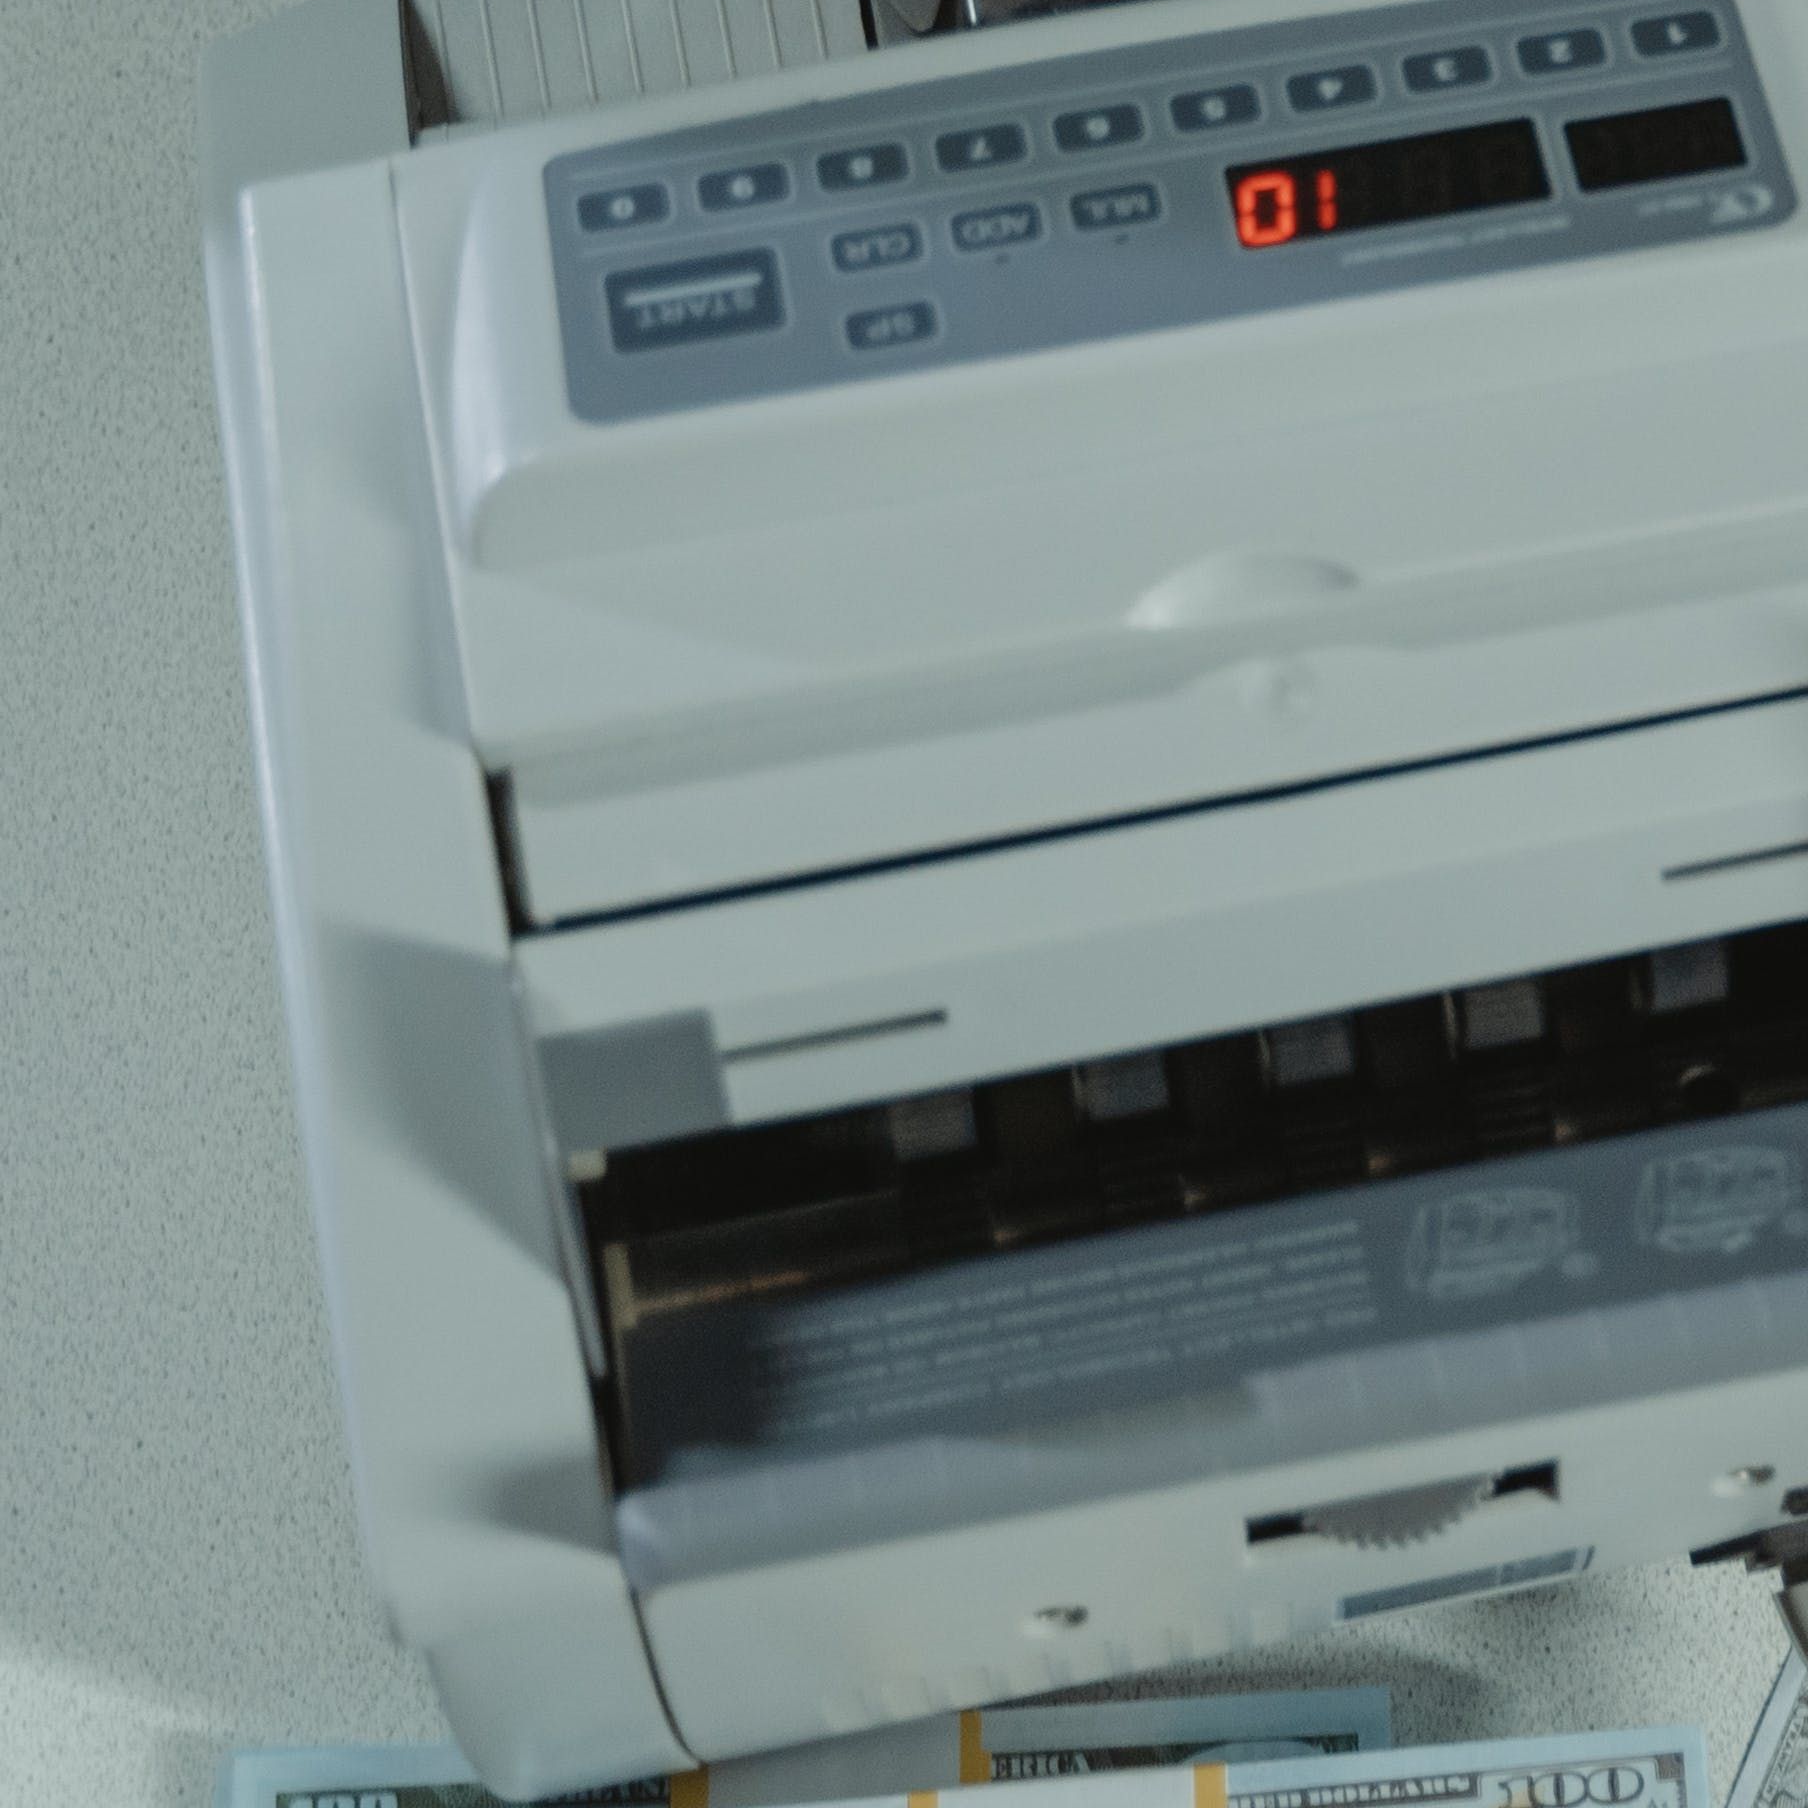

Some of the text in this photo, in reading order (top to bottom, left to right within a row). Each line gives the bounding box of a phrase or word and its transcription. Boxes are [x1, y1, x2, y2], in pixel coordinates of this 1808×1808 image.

[843, 230, 910, 260] CLR
[635, 287, 756, 330] START
[990, 1748, 1091, 1781] ERICA
